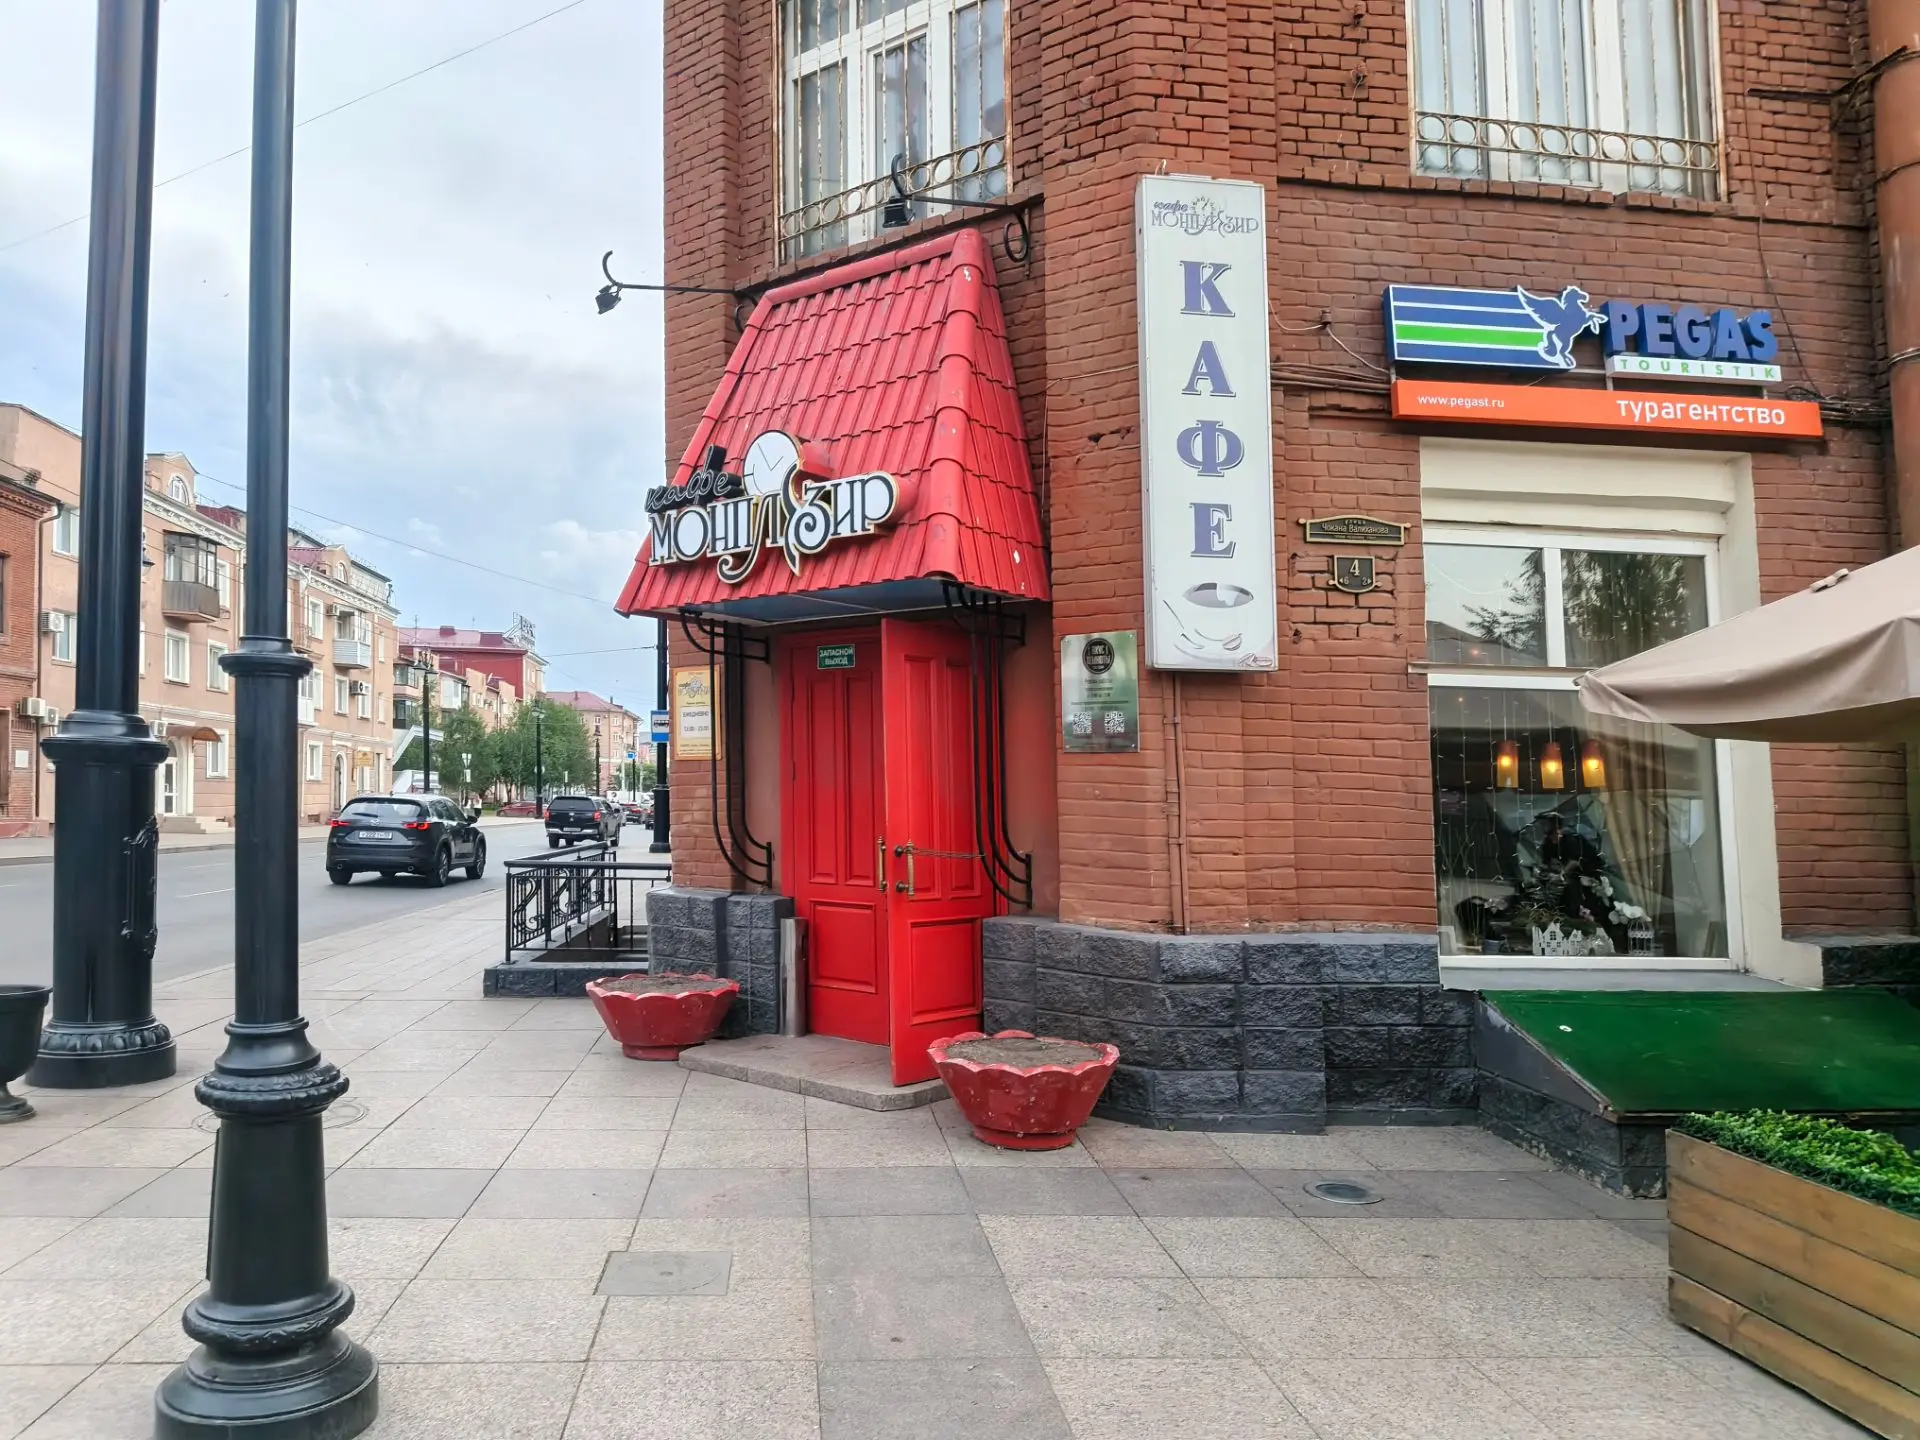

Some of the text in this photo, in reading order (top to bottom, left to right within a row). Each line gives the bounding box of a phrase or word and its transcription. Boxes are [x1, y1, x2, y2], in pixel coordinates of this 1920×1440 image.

[1602, 300, 1778, 361] PEGAS
[1620, 359, 1775, 379] TOURISTIK
[1177, 260, 1245, 559] КАФЕ
[1417, 396, 1505, 408] www.pegast.ru
[1616, 400, 1786, 425] турагентство
[645, 445, 732, 511] кафе
[1349, 559, 1360, 576] 4
[1362, 577, 1367, 585] 2
